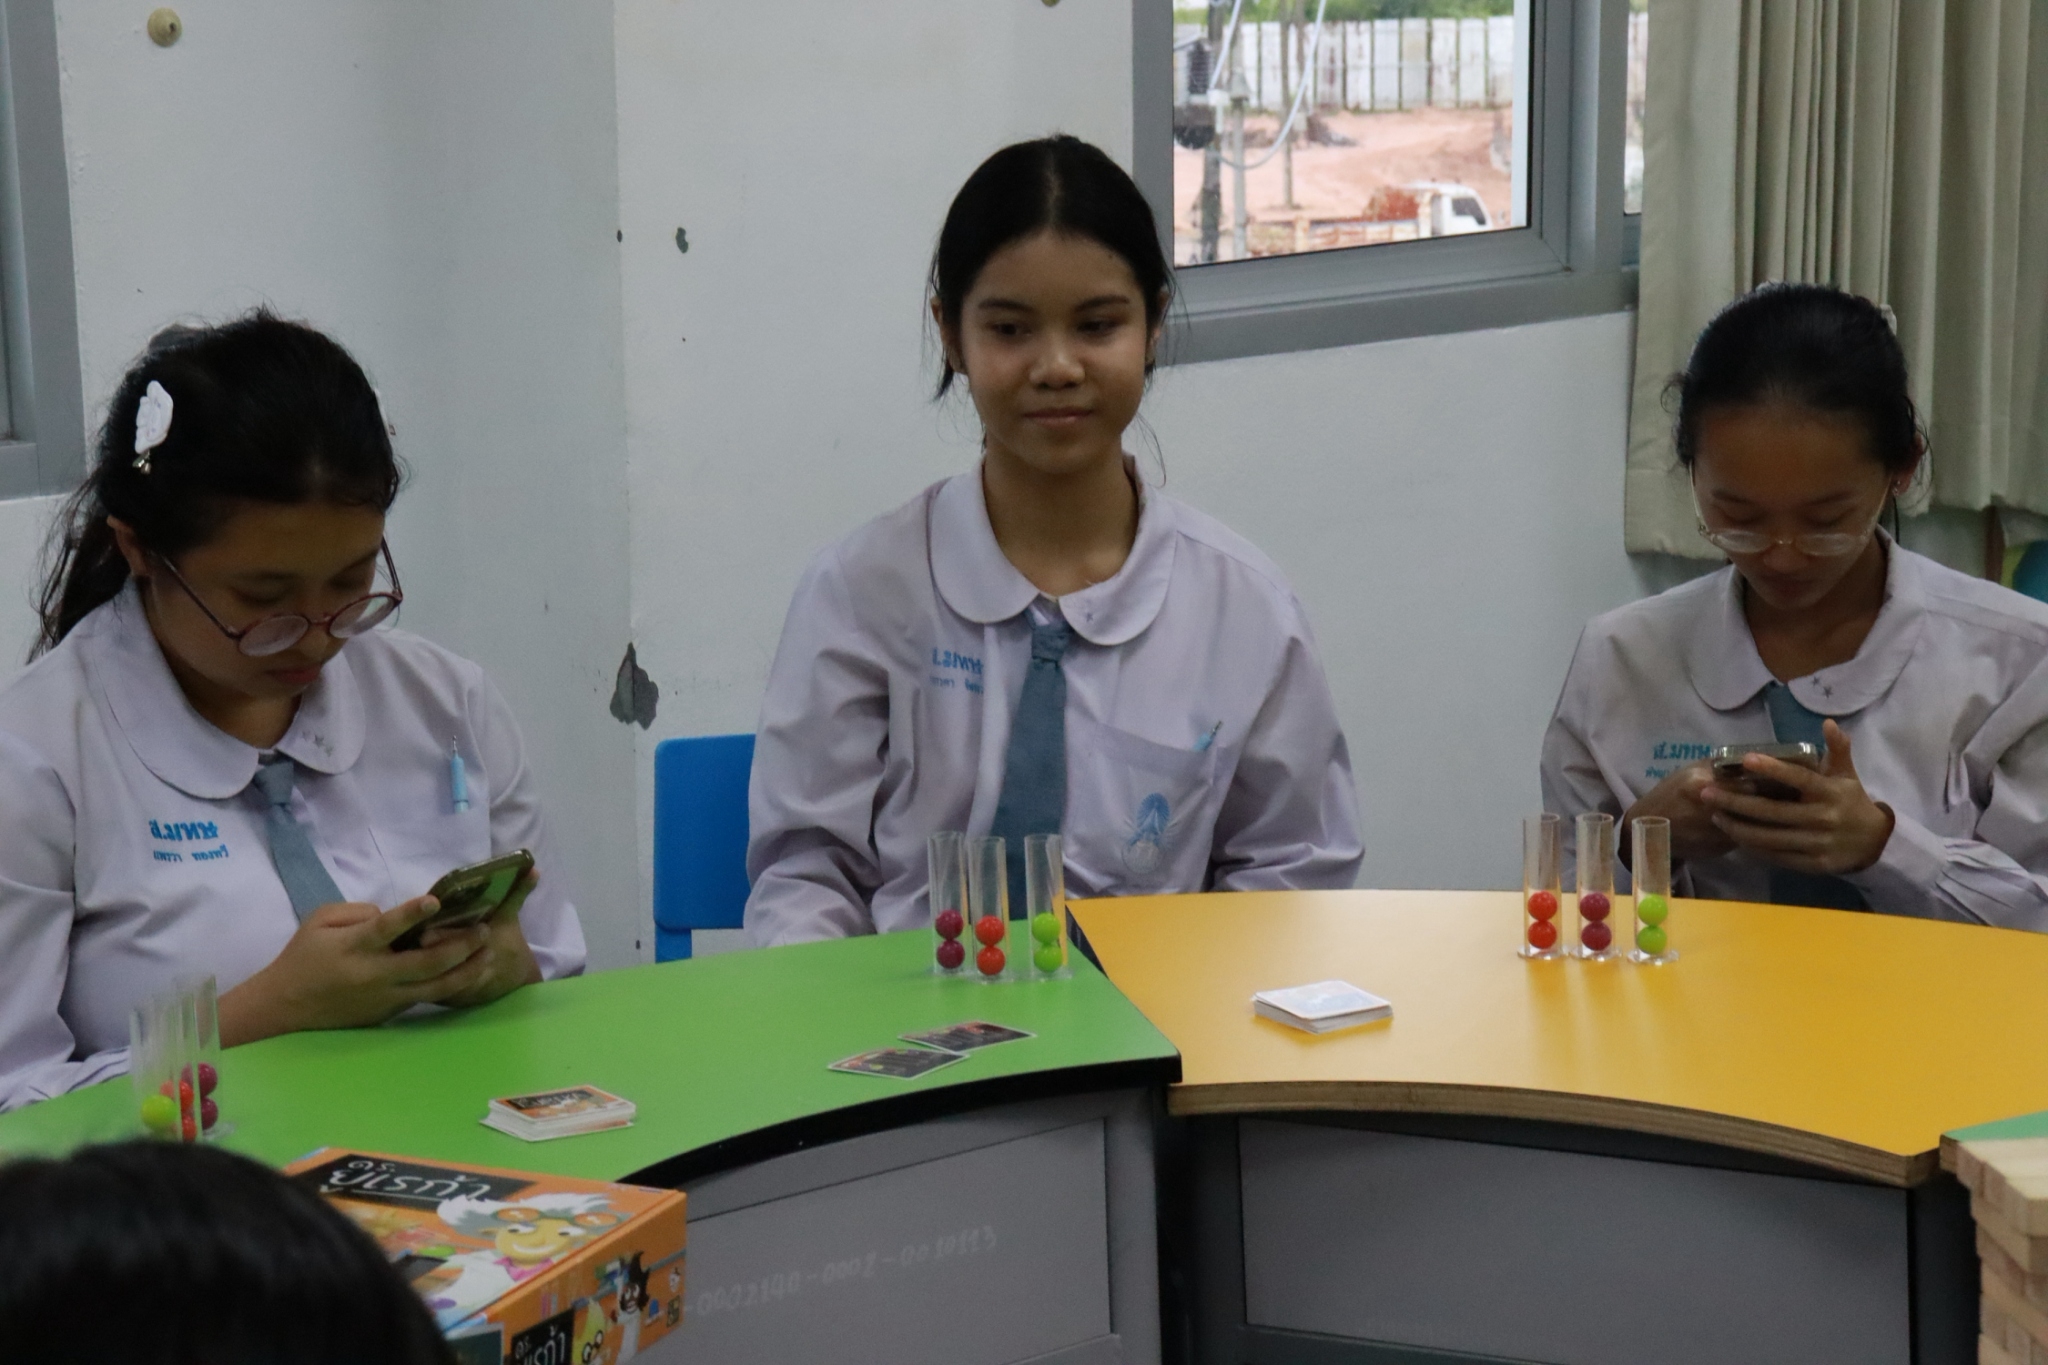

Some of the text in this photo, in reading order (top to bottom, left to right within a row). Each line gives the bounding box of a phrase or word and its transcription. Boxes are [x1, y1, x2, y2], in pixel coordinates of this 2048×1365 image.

[347, 1160, 396, 1173] ดร.
[319, 1169, 492, 1200] ยูเรก้า
